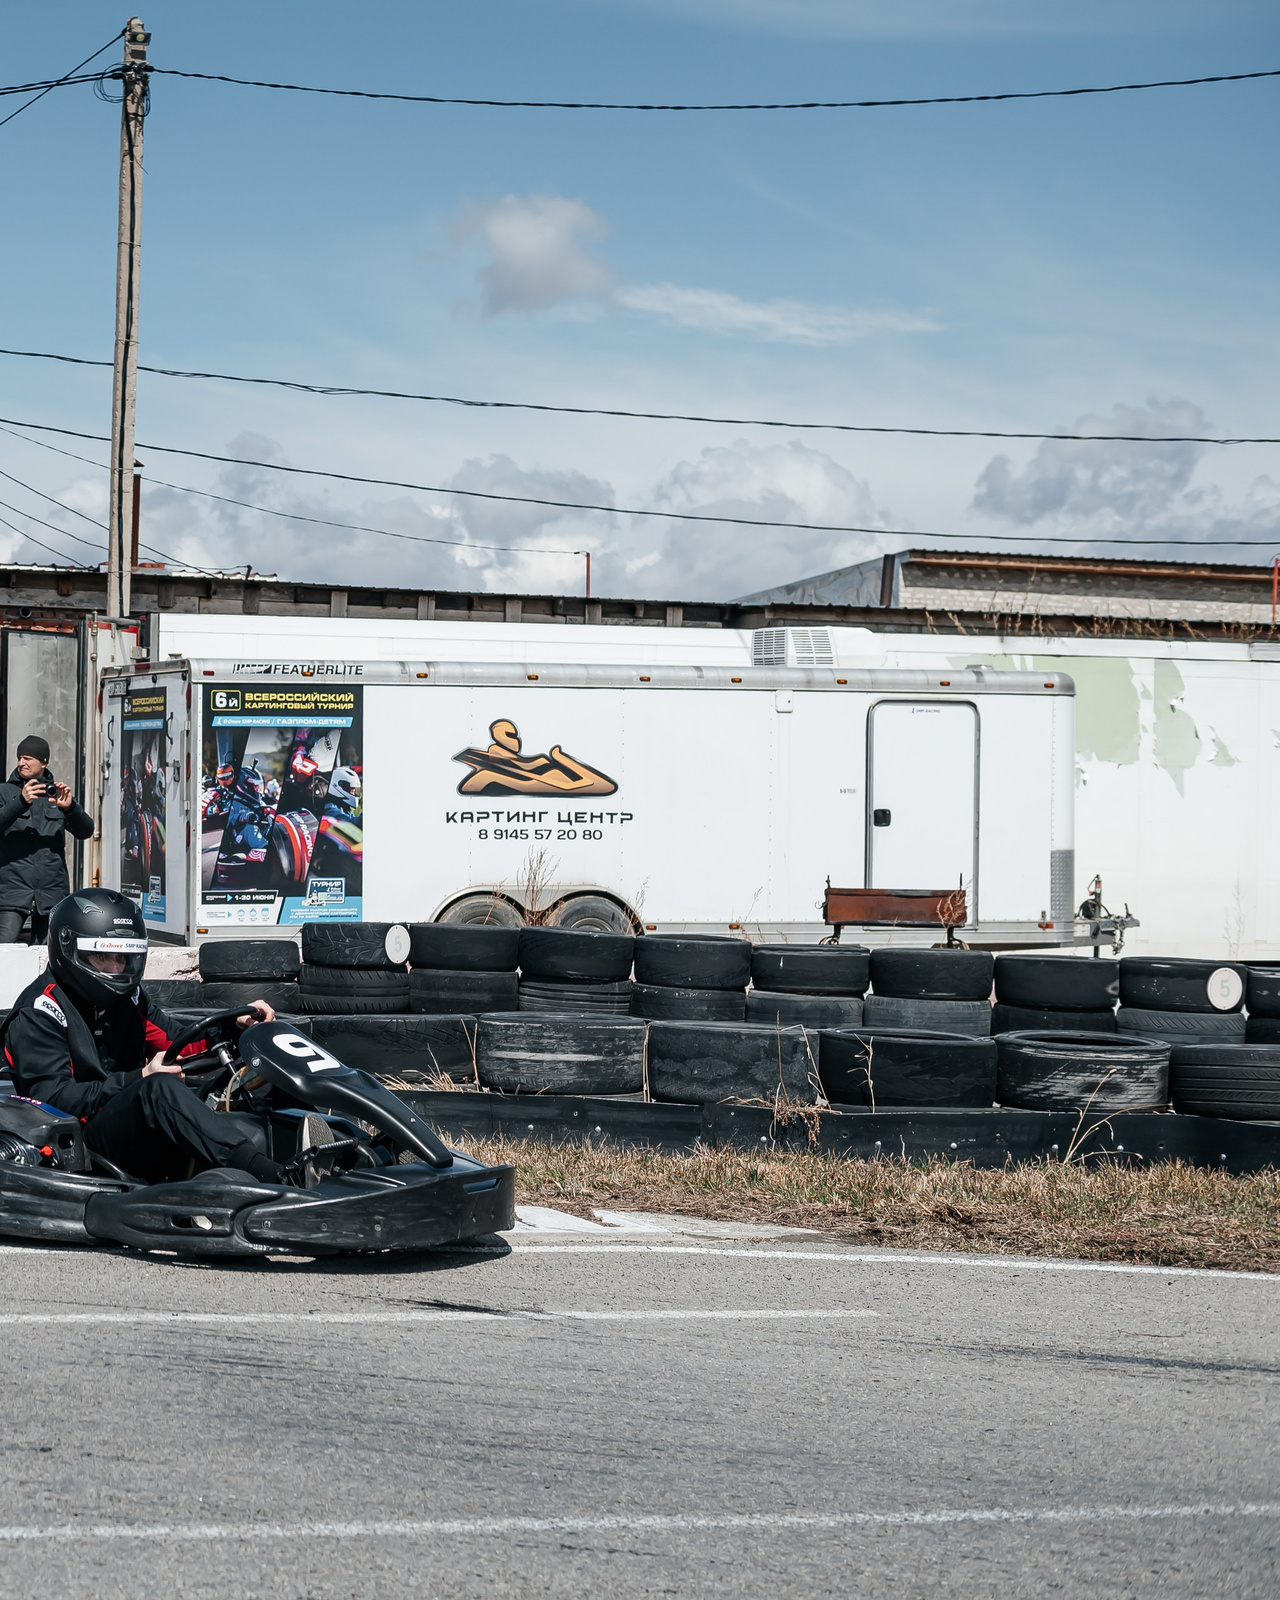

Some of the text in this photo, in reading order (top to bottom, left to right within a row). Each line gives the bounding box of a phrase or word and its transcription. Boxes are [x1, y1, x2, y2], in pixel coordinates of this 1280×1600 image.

[273, 664, 363, 675] FEATHERLITE
[244, 692, 354, 702] ВСЕРОССИЙСКИЙ
[244, 702, 354, 710] КАРТИНГОВЫЙ ТУРНИР
[276, 718, 347, 726] ГАЗПРОМ-ДЕТЯМ
[445, 811, 634, 826] КАРТИНГ ЦЕНТР
[301, 824, 313, 857] RACING
[478, 829, 603, 840] 8 9145 57 20 80
[394, 934, 403, 953] 5
[1220, 979, 1230, 998] 5
[272, 1033, 341, 1073] 9
